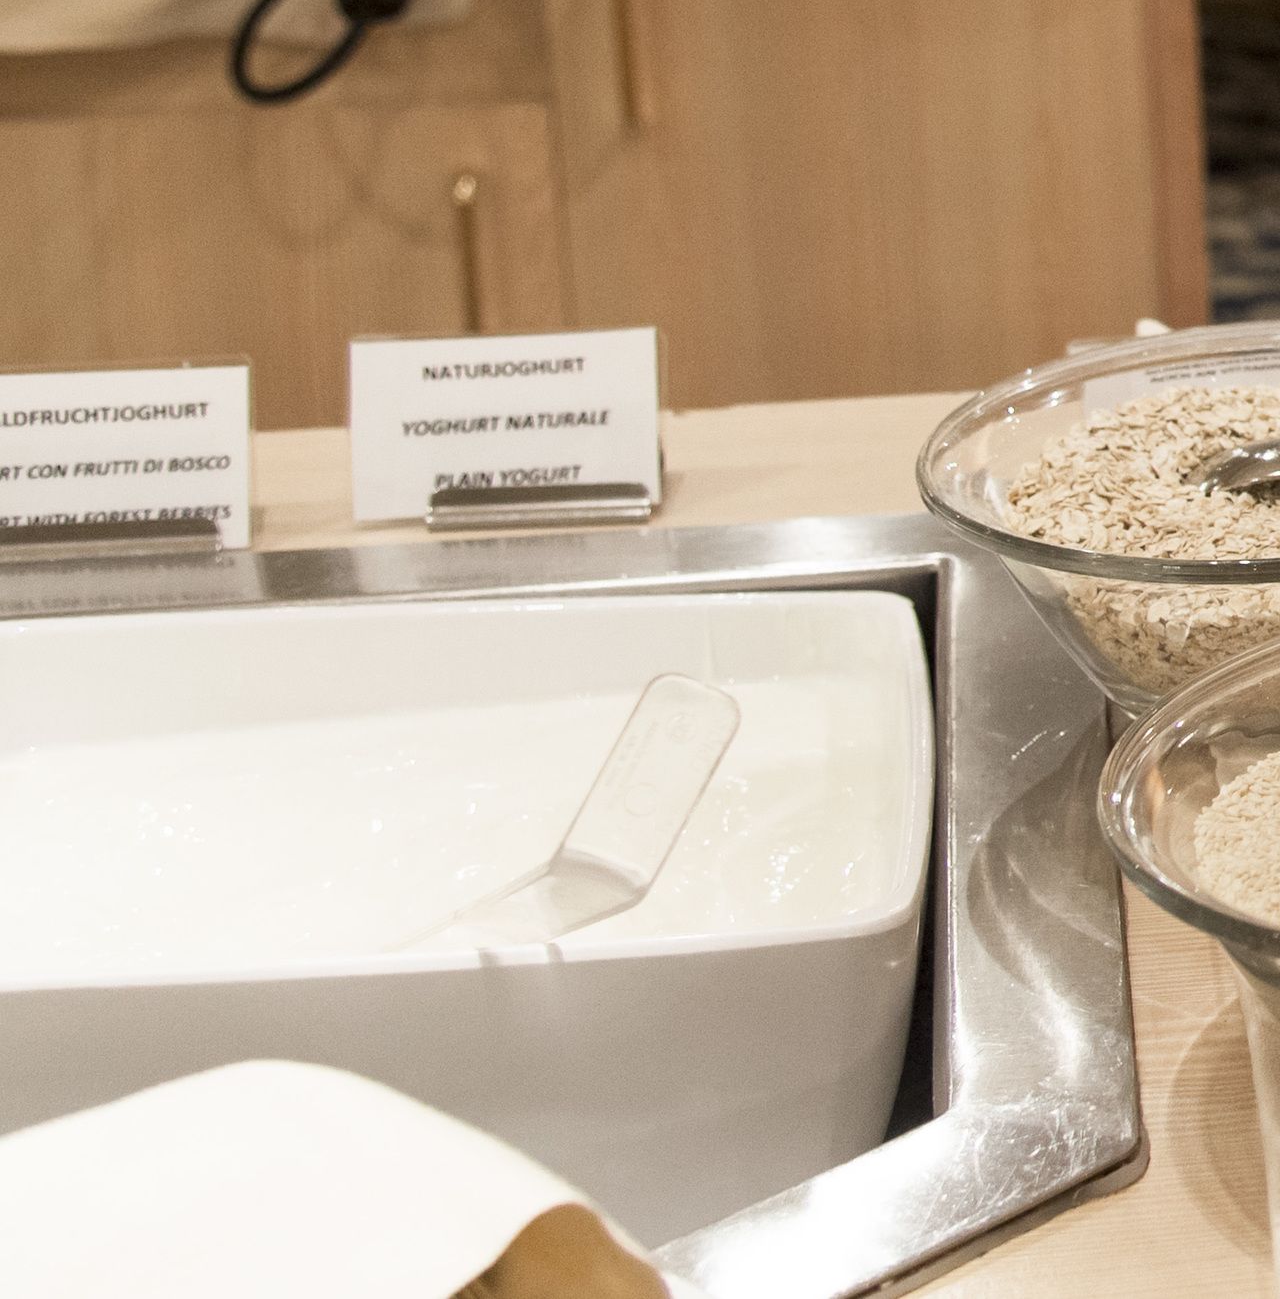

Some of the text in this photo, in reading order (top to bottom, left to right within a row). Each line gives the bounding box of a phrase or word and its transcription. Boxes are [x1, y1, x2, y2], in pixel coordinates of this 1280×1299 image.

[422, 357, 585, 380] NATURJOGHURT
[0, 402, 209, 427] LDFRUCHTJOGHURT
[401, 409, 610, 436] YOGHURT NATURALE
[27, 464, 68, 480] CON
[73, 459, 139, 477] FRUTTI
[143, 458, 163, 474] DI
[168, 454, 231, 473] BOSCO
[435, 465, 582, 488] PLAIN YOGURT
